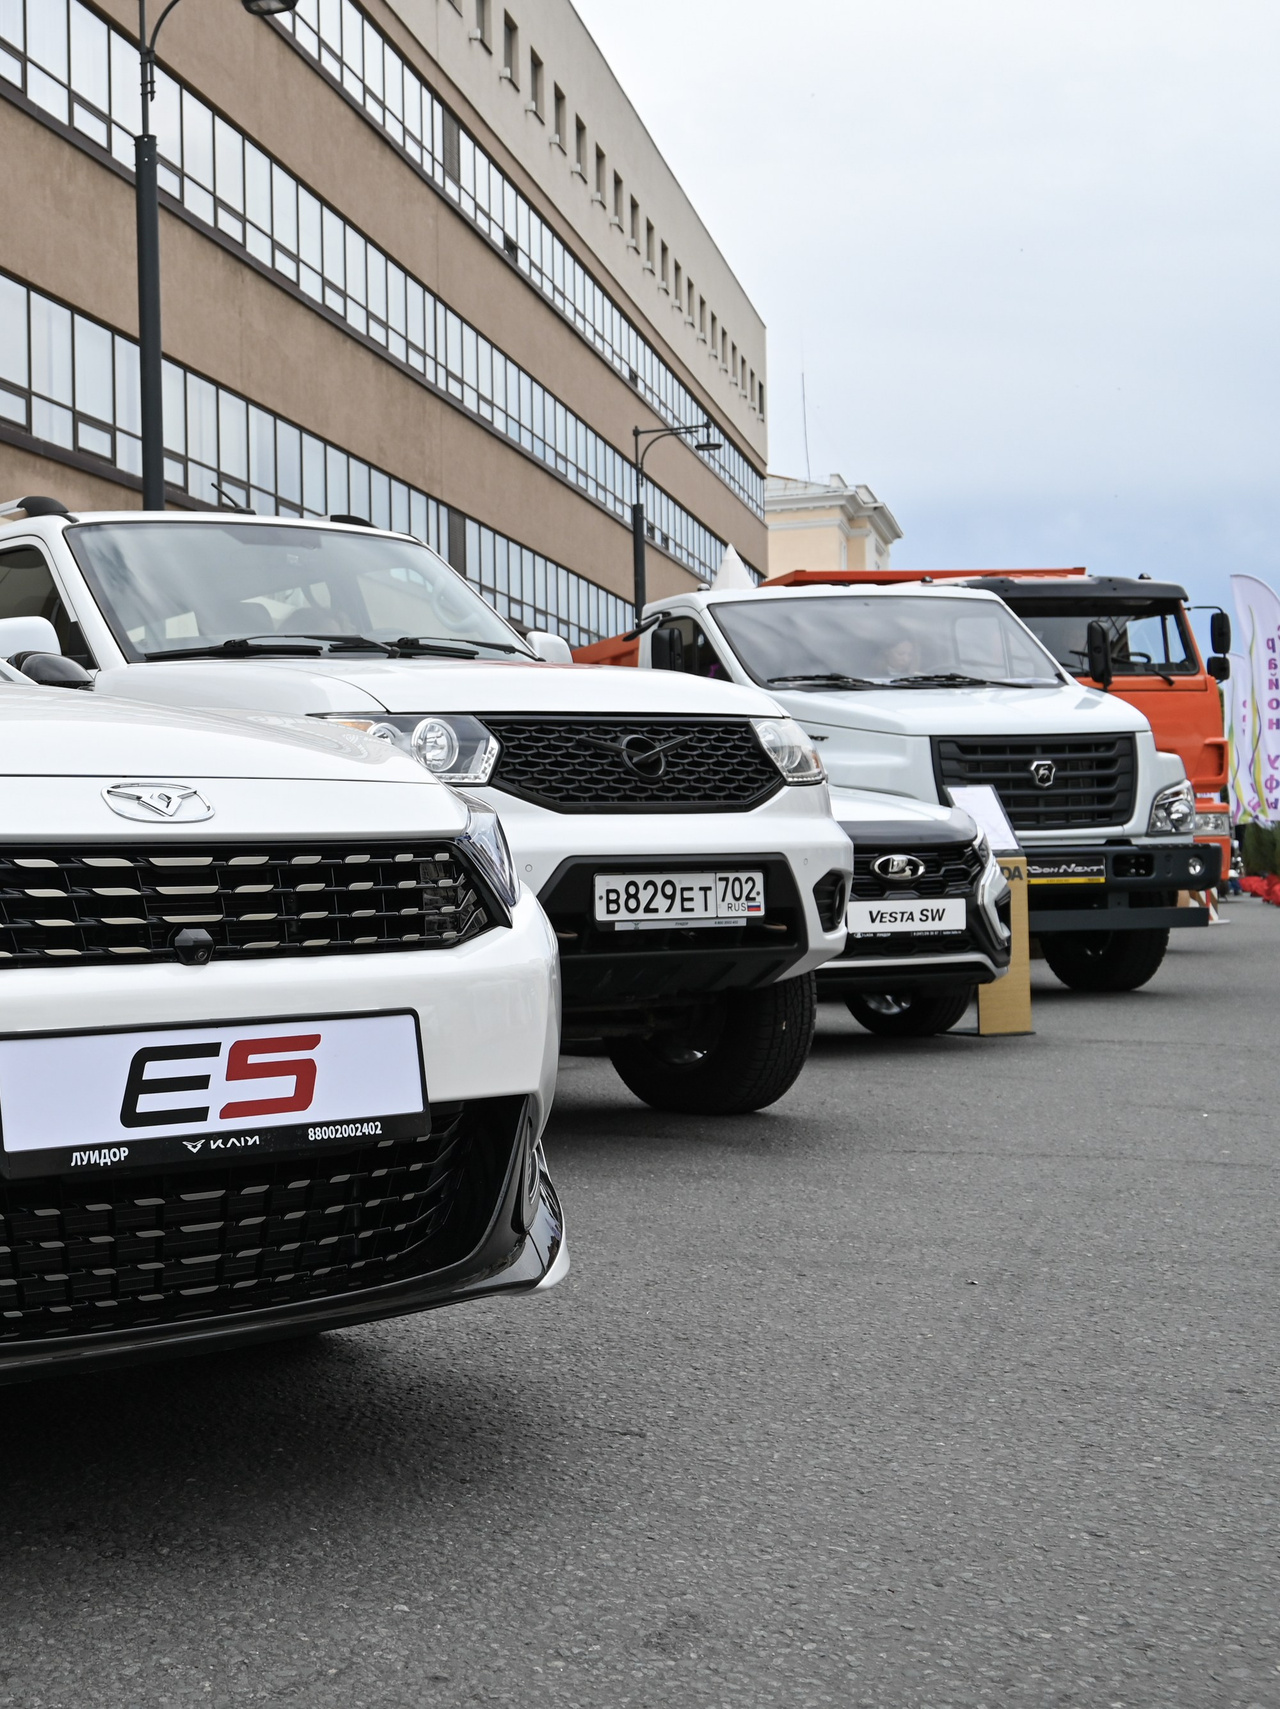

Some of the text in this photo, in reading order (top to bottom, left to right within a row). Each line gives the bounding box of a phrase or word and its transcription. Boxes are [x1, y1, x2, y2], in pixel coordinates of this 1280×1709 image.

[1000, 865, 1024, 881] DA
[718, 876, 757, 902] 702
[727, 902, 747, 912] RUS
[919, 908, 946, 923] SW
[307, 1121, 383, 1141] 88002002402
[70, 1147, 130, 1167] ЛУИДОР
